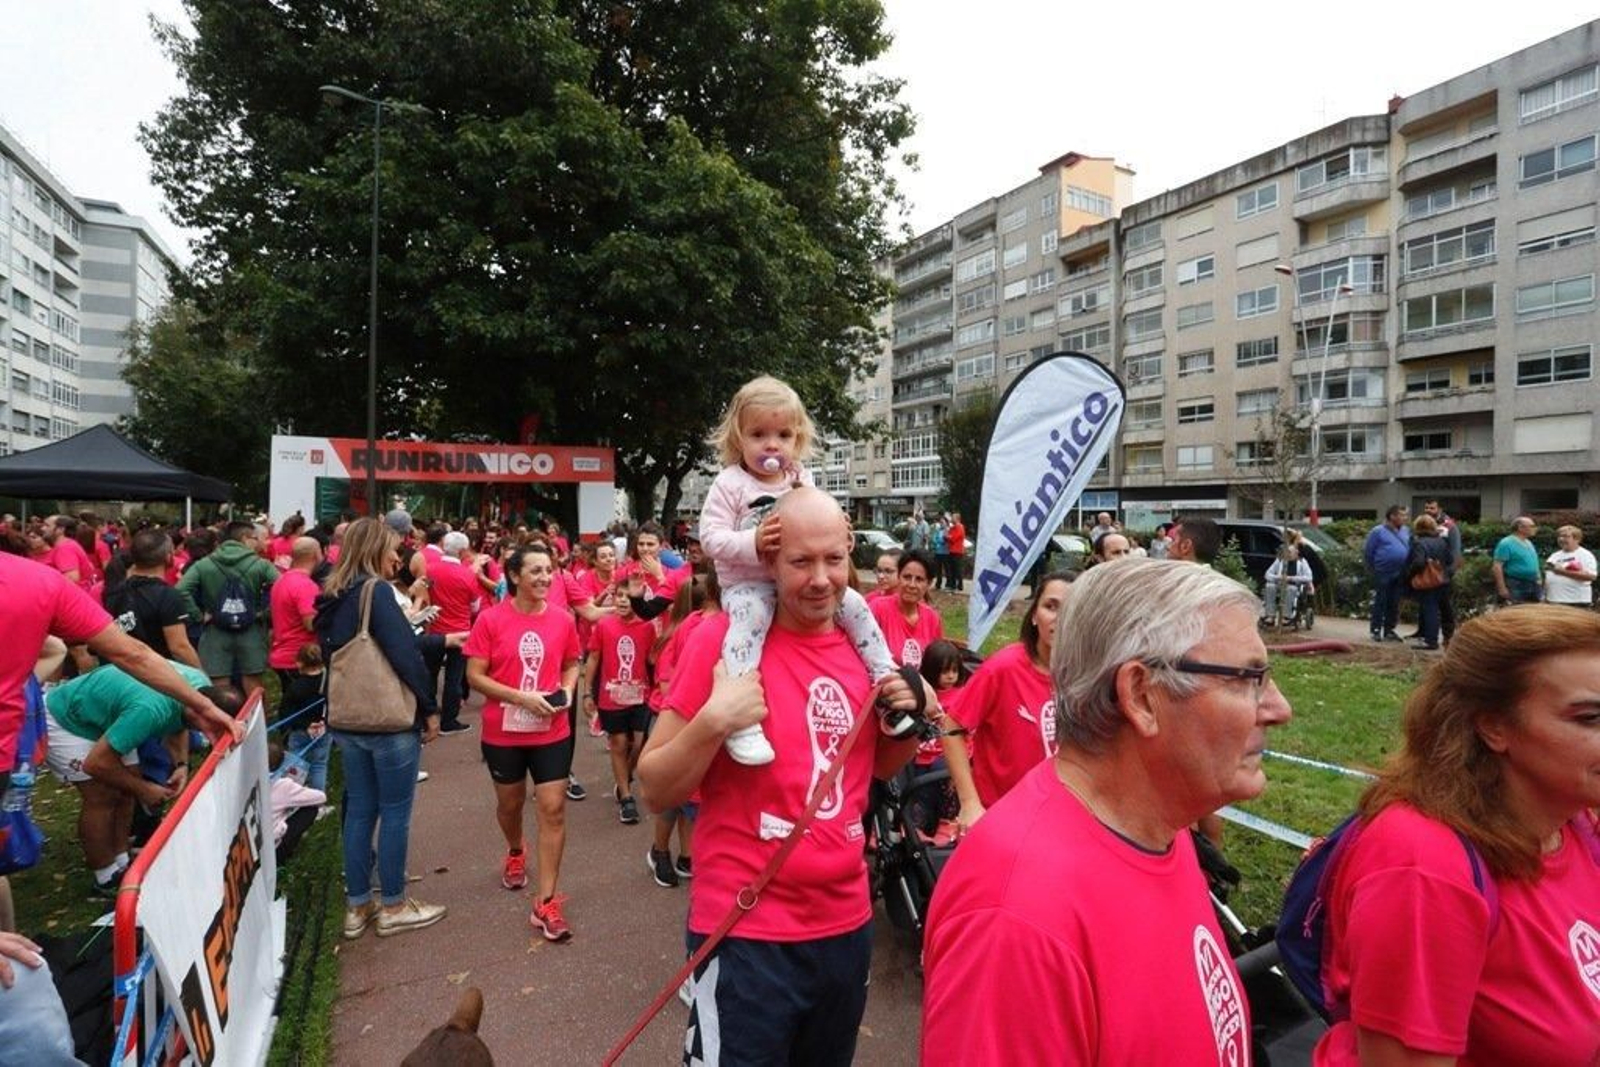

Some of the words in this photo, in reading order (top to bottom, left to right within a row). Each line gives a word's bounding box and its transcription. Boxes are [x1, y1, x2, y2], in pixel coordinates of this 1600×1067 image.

[977, 391, 1109, 615] Atlántico
[818, 686, 835, 700] VI
[815, 705, 846, 719] VIGO
